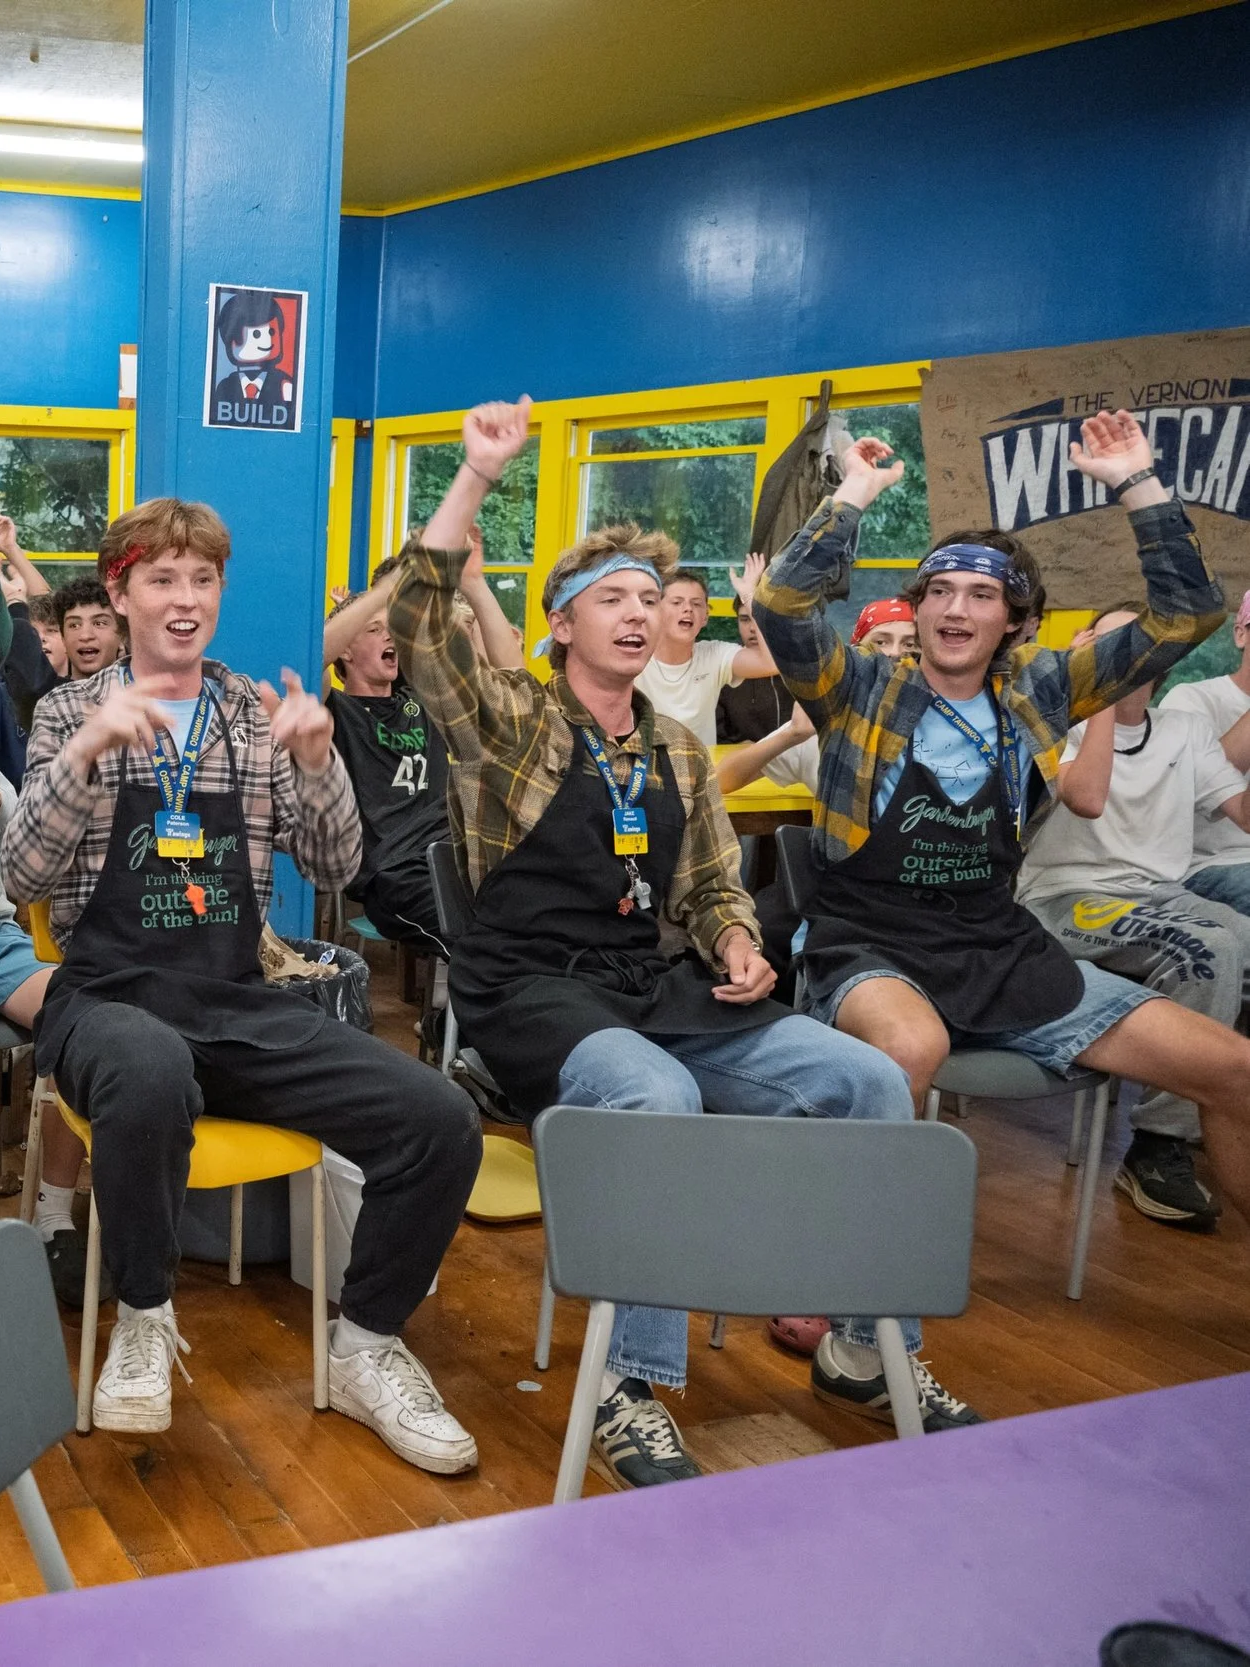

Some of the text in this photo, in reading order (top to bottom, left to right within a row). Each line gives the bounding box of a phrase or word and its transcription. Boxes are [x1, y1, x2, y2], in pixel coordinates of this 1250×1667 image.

[1069, 379, 1226, 413] THE VERNON
[217, 401, 288, 425] BUILD
[987, 405, 1250, 533] WHECA
[189, 714, 204, 747] TAWINGO
[934, 700, 955, 718] CAMP
[952, 715, 981, 743] TAWINGO
[179, 765, 191, 789] CAMP
[391, 753, 429, 796] 42
[603, 767, 616, 788] CAMP
[628, 771, 643, 801] TAWINGO
[912, 838, 989, 855] I'm thinking
[145, 874, 167, 887] I'm
[899, 863, 992, 885] of the bun!
[140, 886, 229, 912] outde
[142, 912, 160, 928] of
[163, 911, 193, 928] the
[1083, 934, 1091, 943] IS
[1094, 936, 1109, 947] THE
